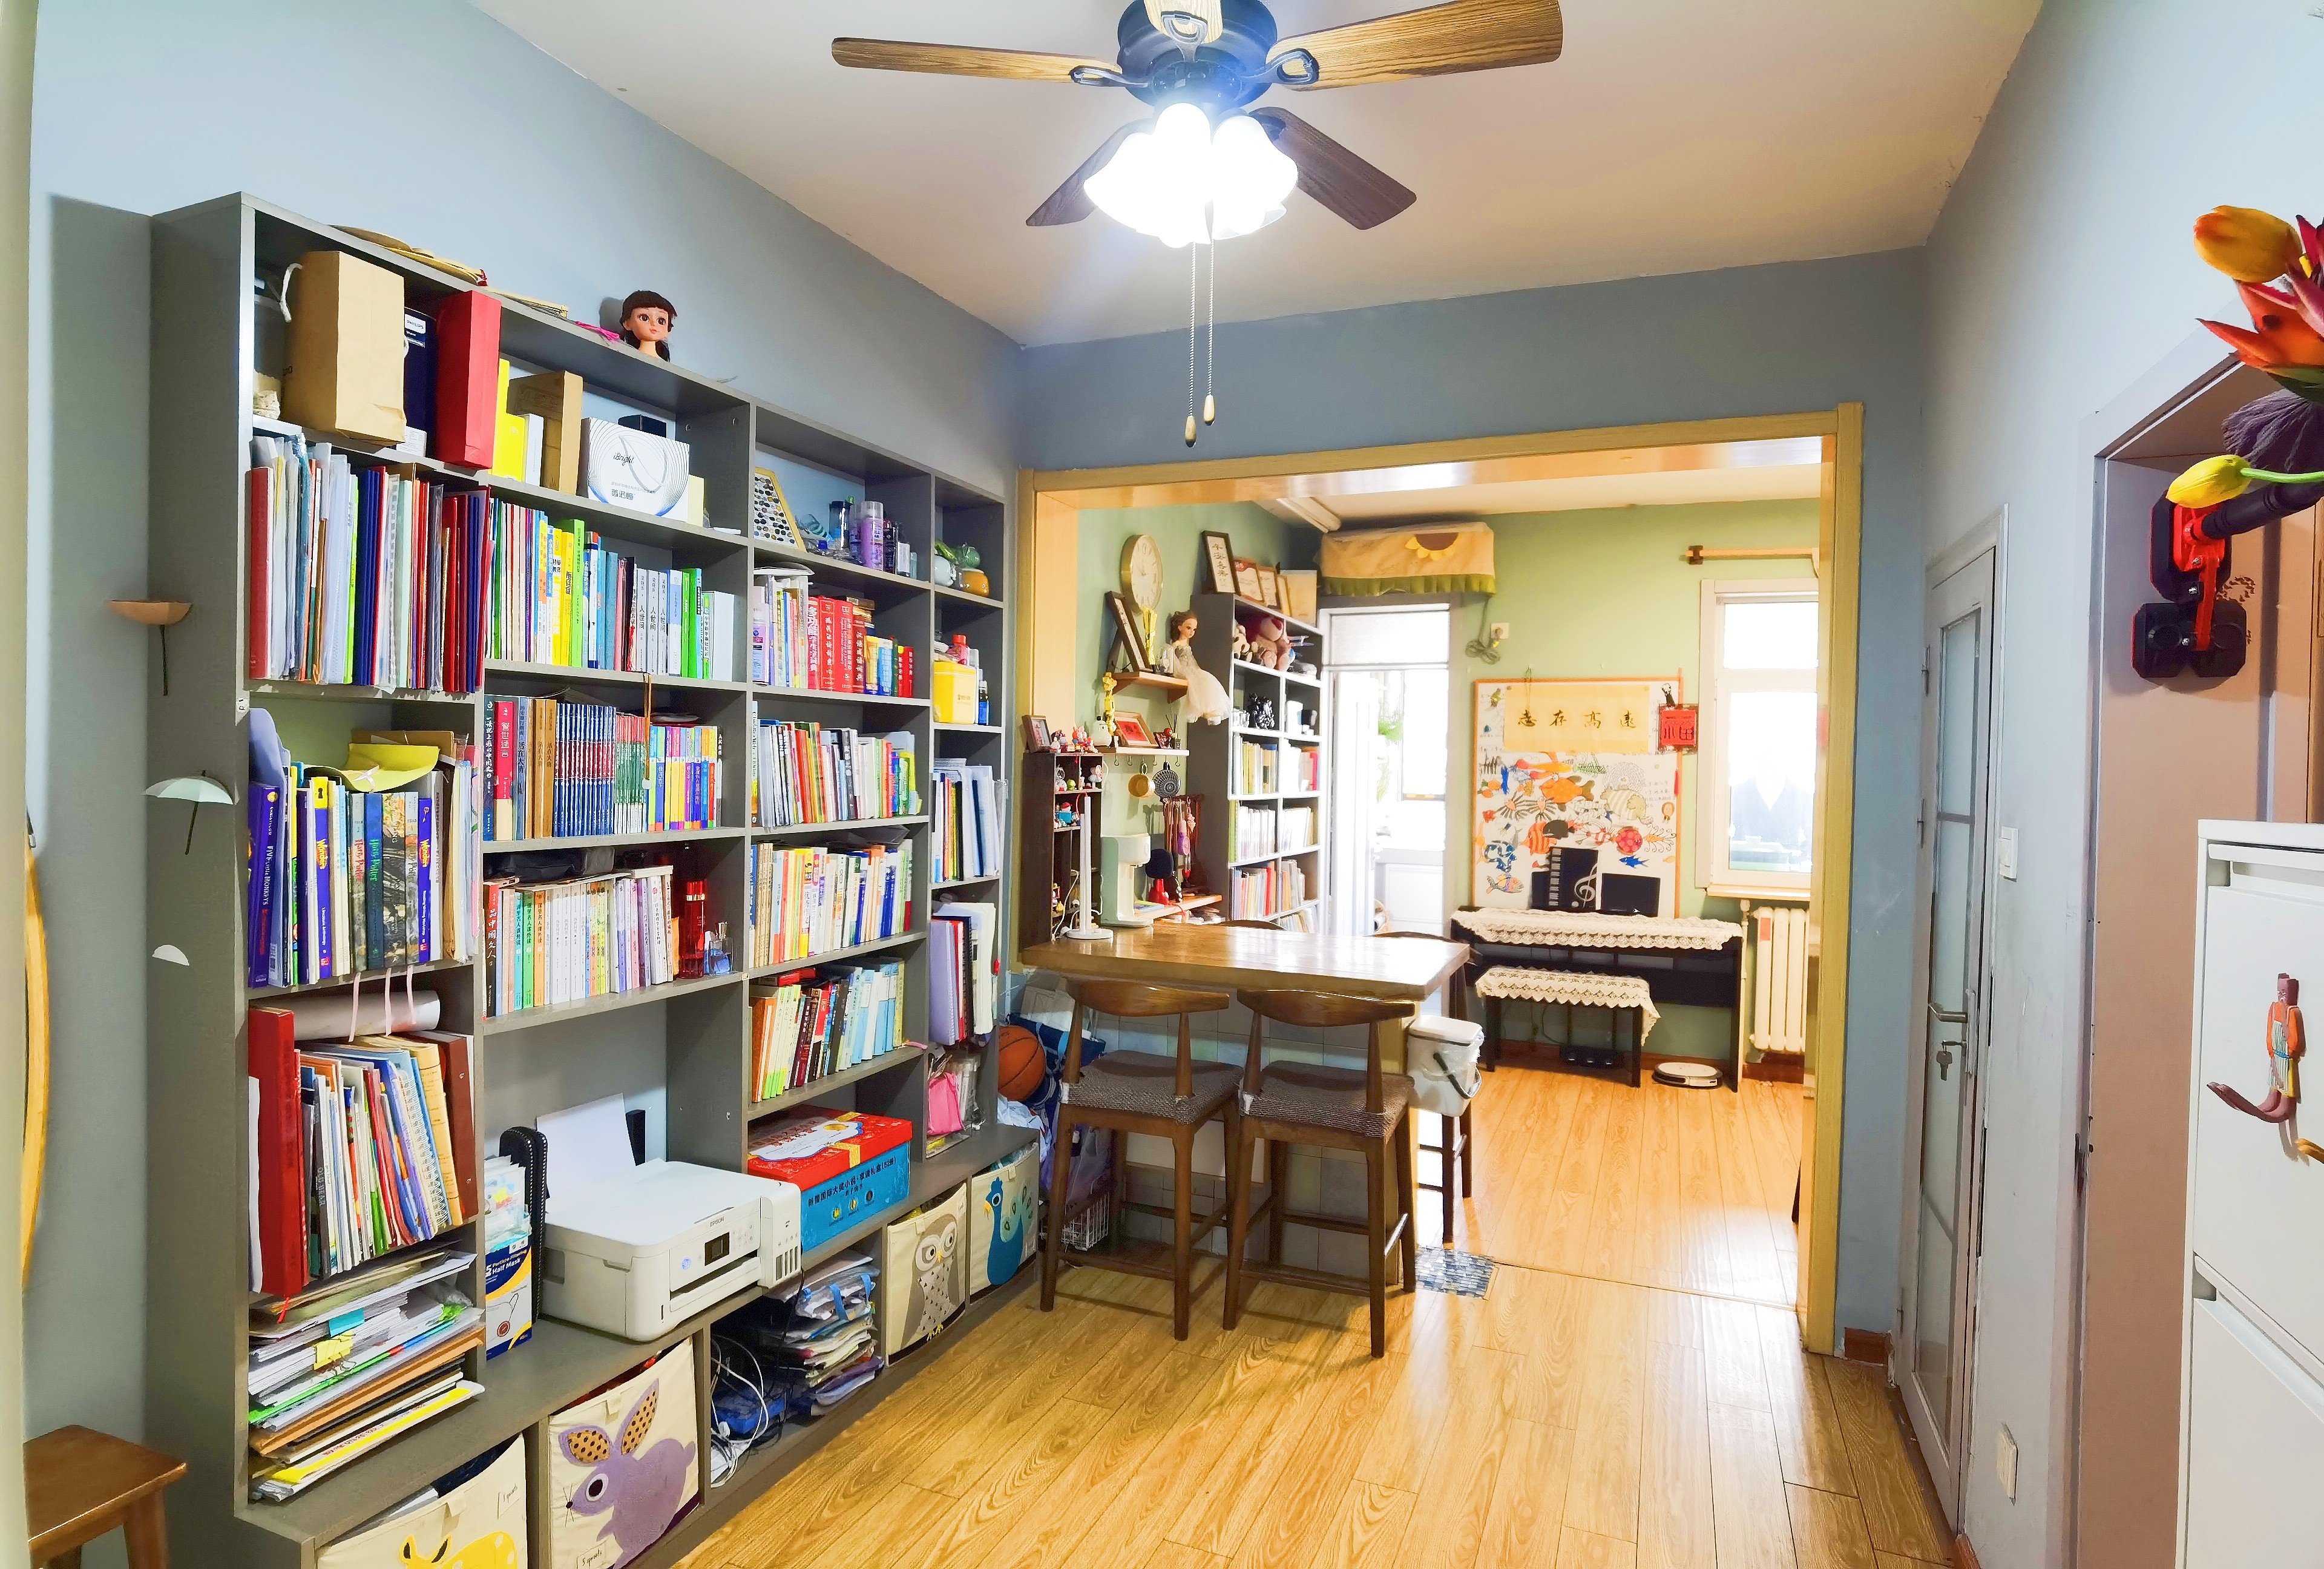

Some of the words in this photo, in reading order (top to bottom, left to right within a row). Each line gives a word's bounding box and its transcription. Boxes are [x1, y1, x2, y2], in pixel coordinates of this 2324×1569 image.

[407, 320, 424, 329] PHILIPS
[613, 453, 635, 466] iBright
[316, 838, 329, 870] Wonders
[369, 838, 379, 858] Harry
[419, 839, 430, 867] Wonders
[369, 859, 381, 881] Potter
[262, 877, 271, 906] MONKEYS
[710, 1217, 724, 1227] EPSON
[492, 1263, 505, 1275] Half
[506, 1257, 521, 1269] Mask
[586, 1548, 602, 1568] sprouts
